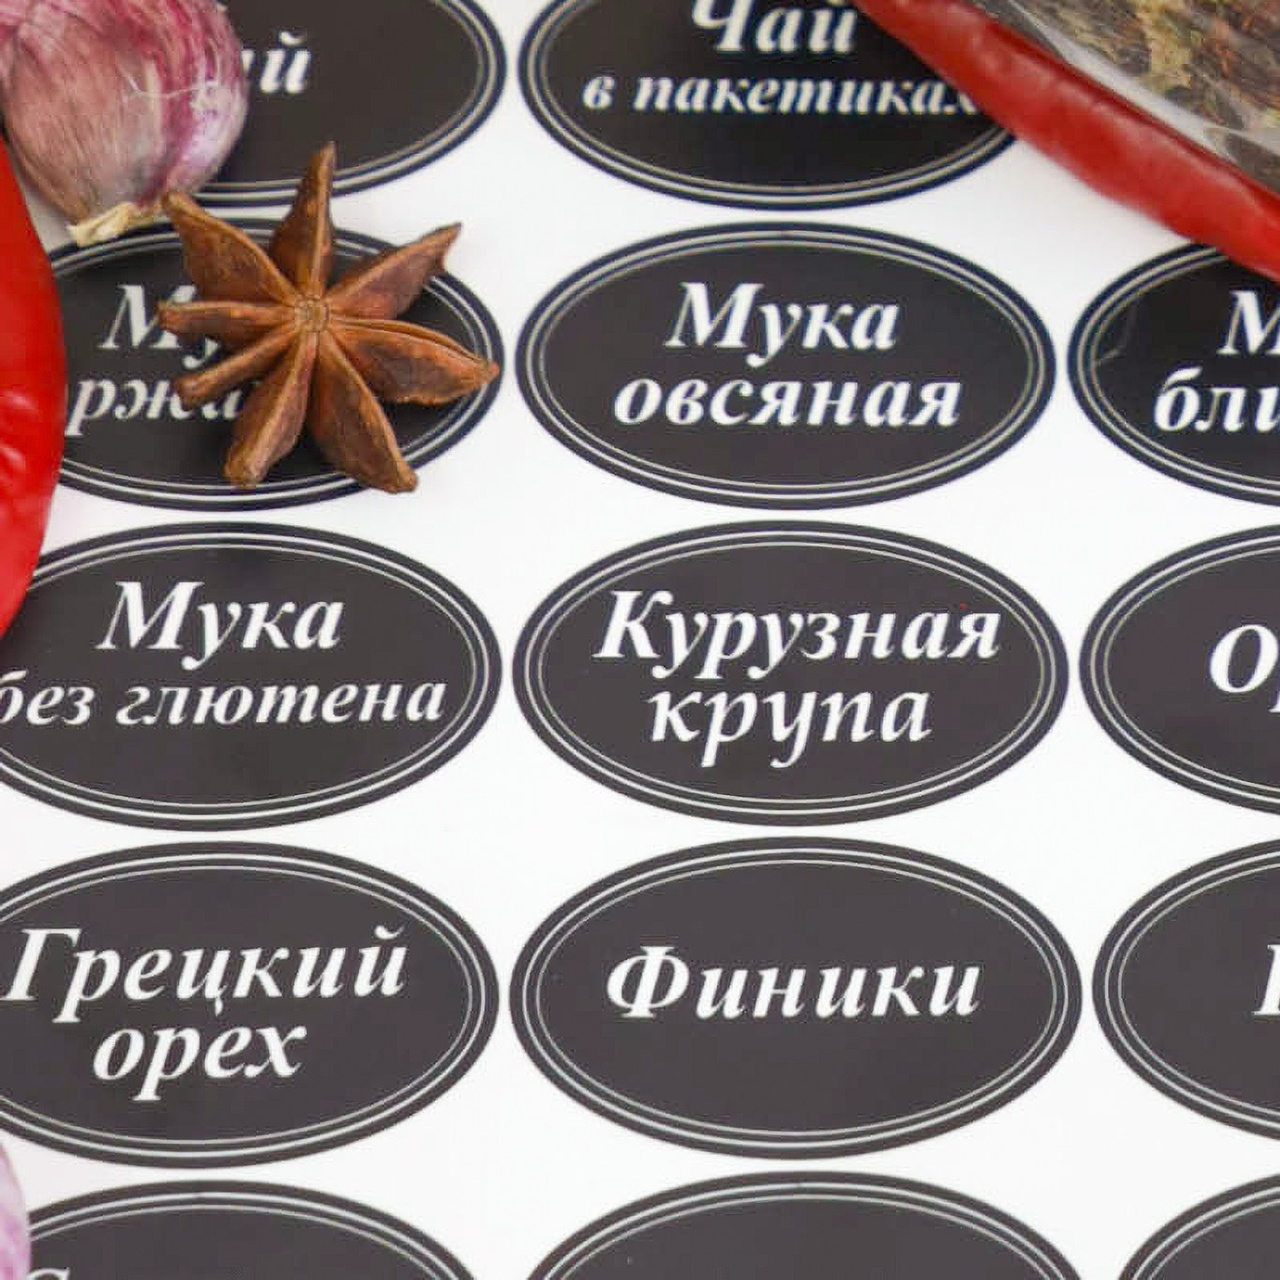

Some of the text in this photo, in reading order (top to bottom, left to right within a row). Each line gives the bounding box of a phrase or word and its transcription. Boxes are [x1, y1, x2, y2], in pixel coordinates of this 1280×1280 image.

[583, 76, 615, 110] в
[665, 282, 899, 370] Мука
[614, 377, 961, 428] овсяная
[96, 580, 344, 671] Мука
[594, 589, 1002, 679] Курузная
[0, 669, 446, 725] без глютена
[648, 681, 932, 769] крупа
[3, 925, 407, 1022] Грецкий
[605, 945, 981, 1019] Финики
[93, 1024, 308, 1101] орех
